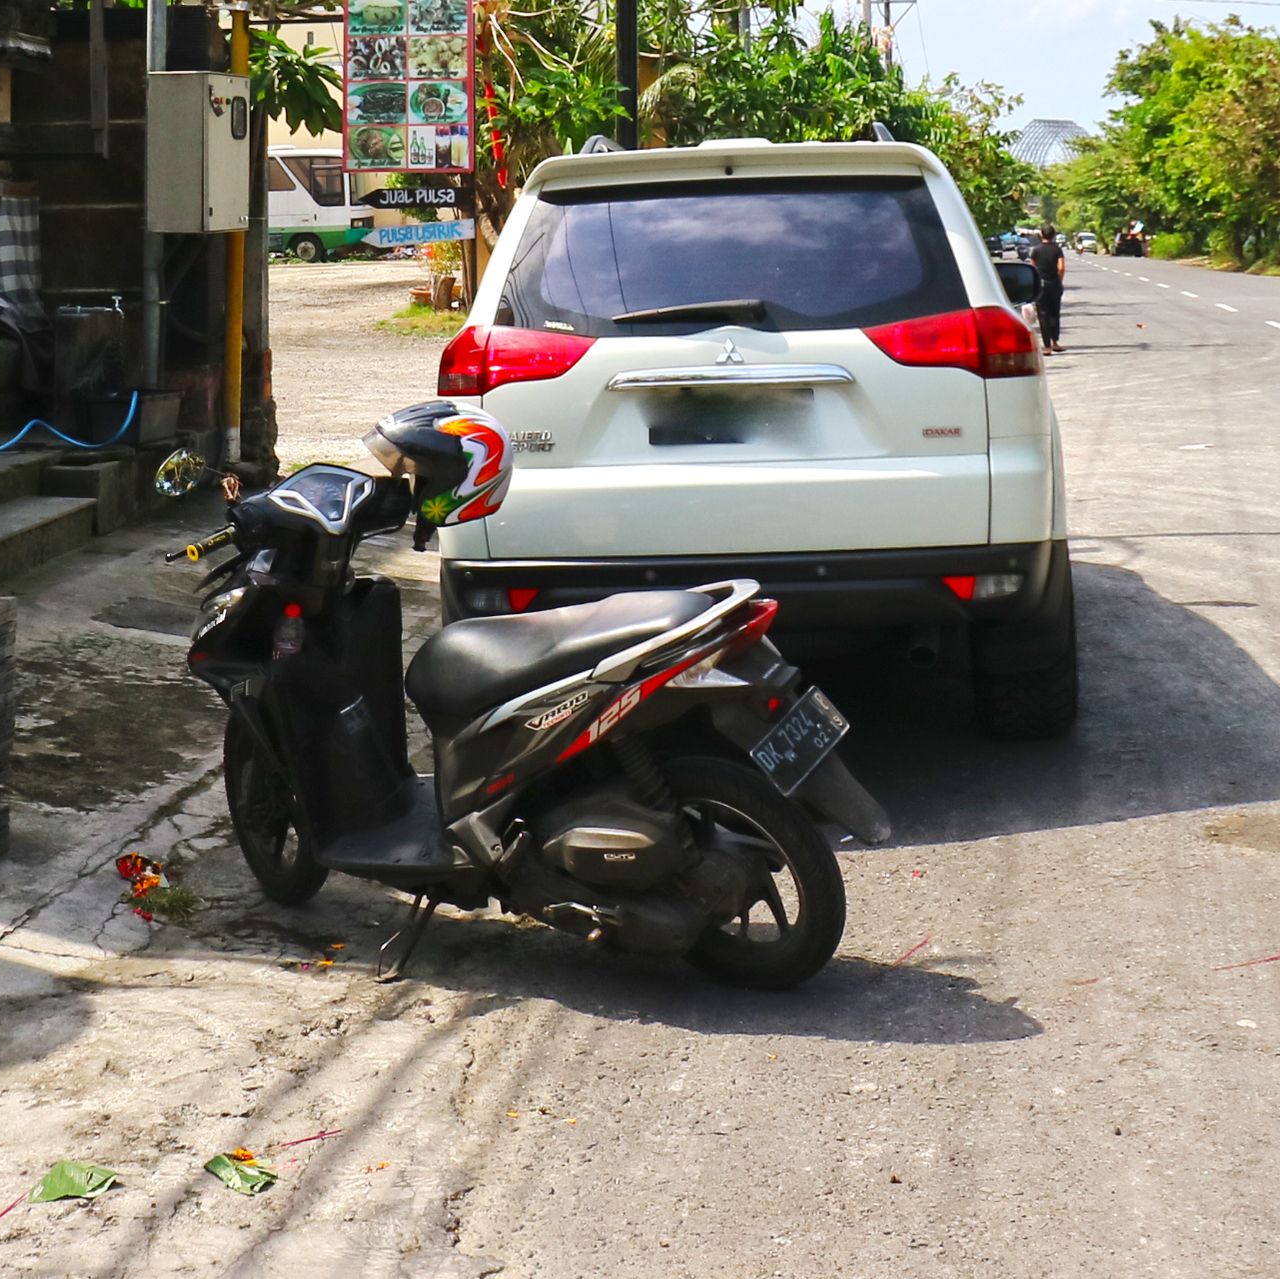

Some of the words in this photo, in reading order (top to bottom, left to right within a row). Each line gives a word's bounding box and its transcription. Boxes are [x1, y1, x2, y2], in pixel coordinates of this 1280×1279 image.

[526, 692, 587, 729] VARIO
[586, 684, 641, 743] 125
[756, 741, 784, 772] DK
